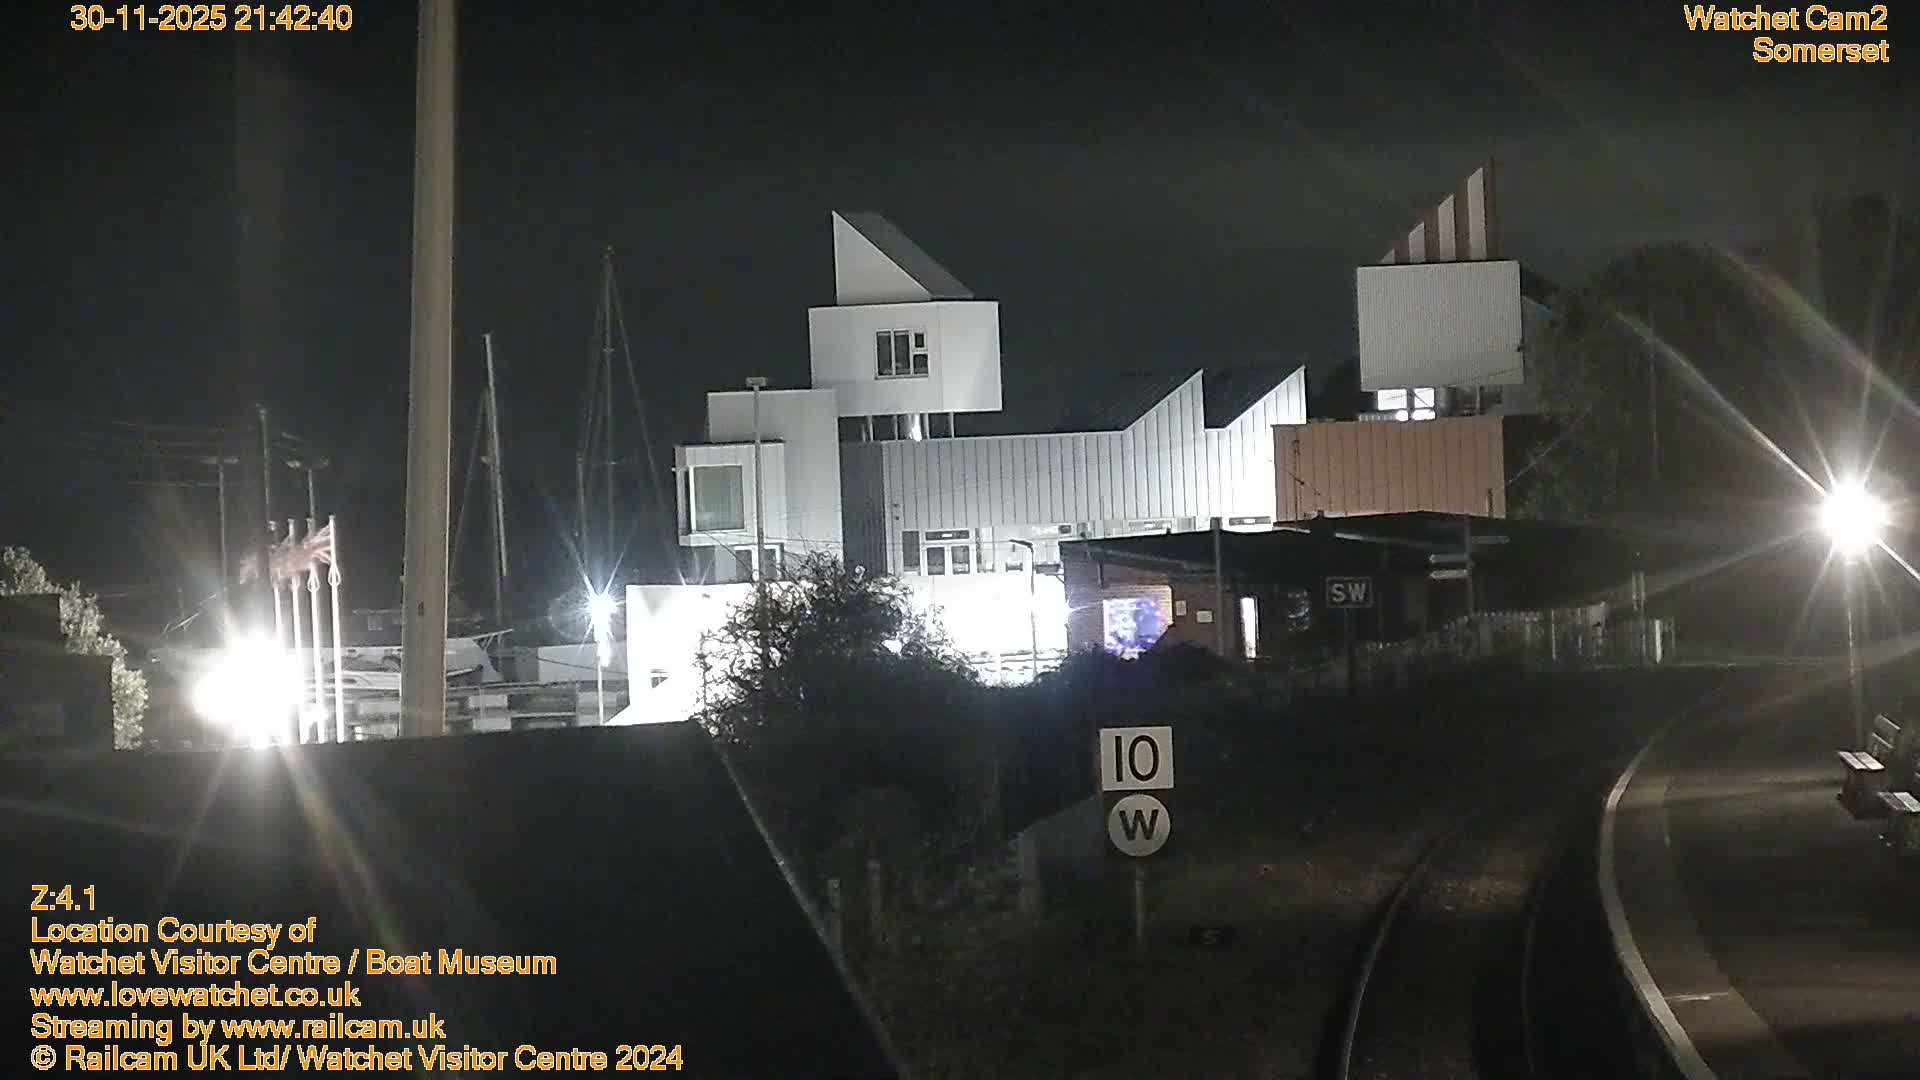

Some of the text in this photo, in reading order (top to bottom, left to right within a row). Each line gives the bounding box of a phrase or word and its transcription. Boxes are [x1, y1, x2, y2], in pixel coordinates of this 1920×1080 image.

[1331, 583, 1366, 602] SW
[1115, 734, 1160, 782] 10
[1119, 808, 1159, 841] W
